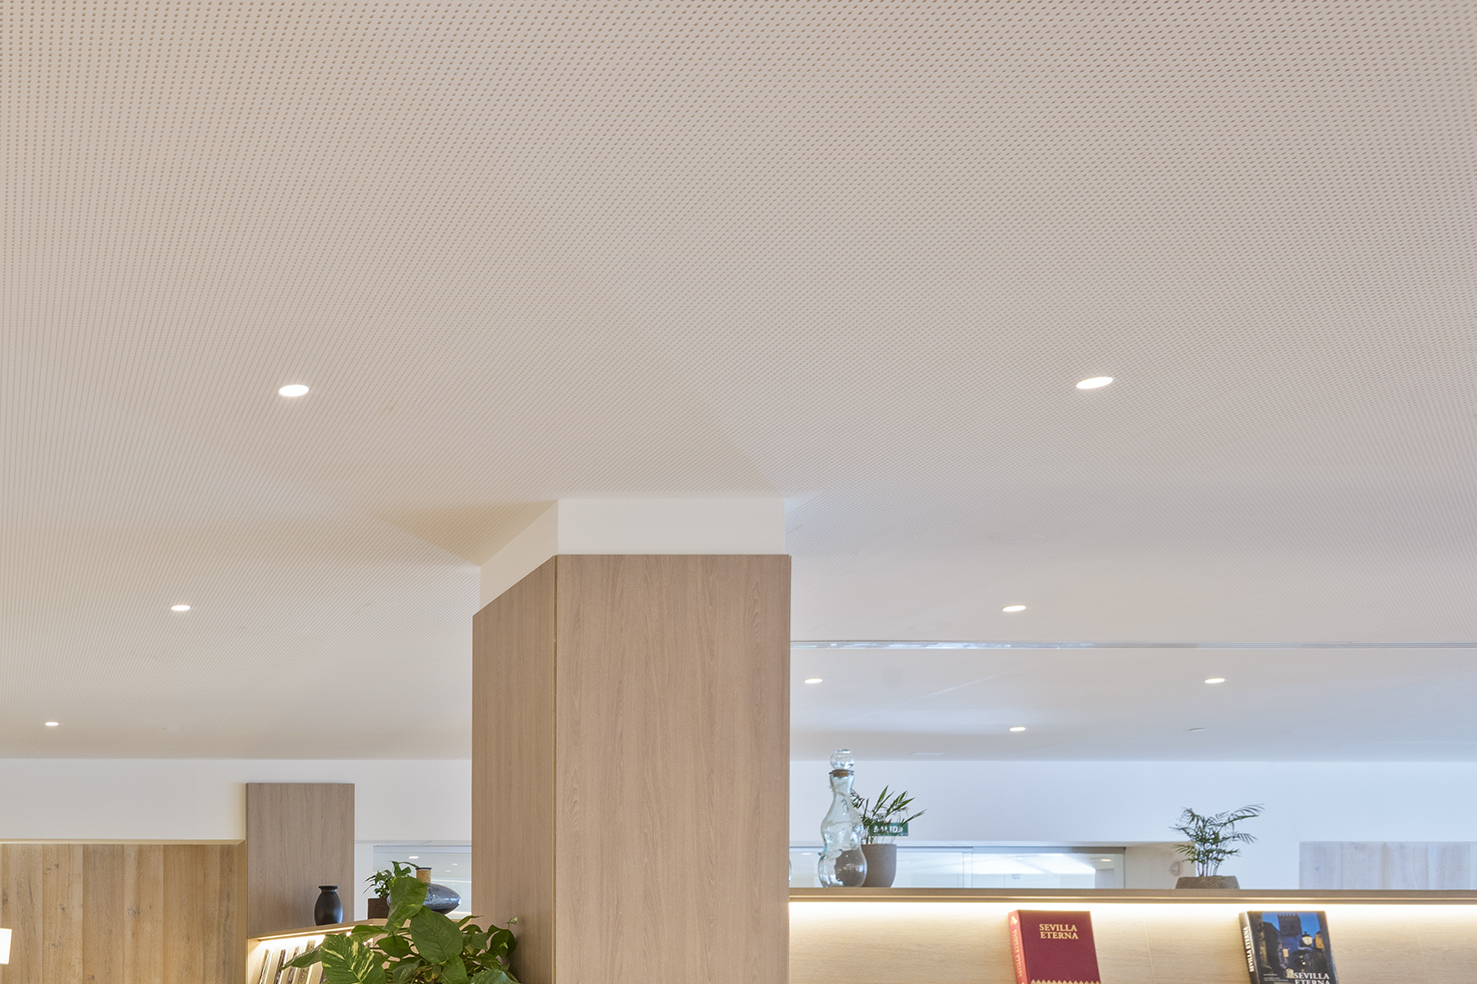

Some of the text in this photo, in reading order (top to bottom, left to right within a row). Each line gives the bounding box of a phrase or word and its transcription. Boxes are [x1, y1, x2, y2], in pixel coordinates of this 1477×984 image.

[1039, 923, 1078, 932] SEVILLA
[1040, 931, 1079, 940] ETERNA
[1242, 926, 1255, 973] SEVILLA ETERNA
[1293, 972, 1330, 980] SEVILLA
